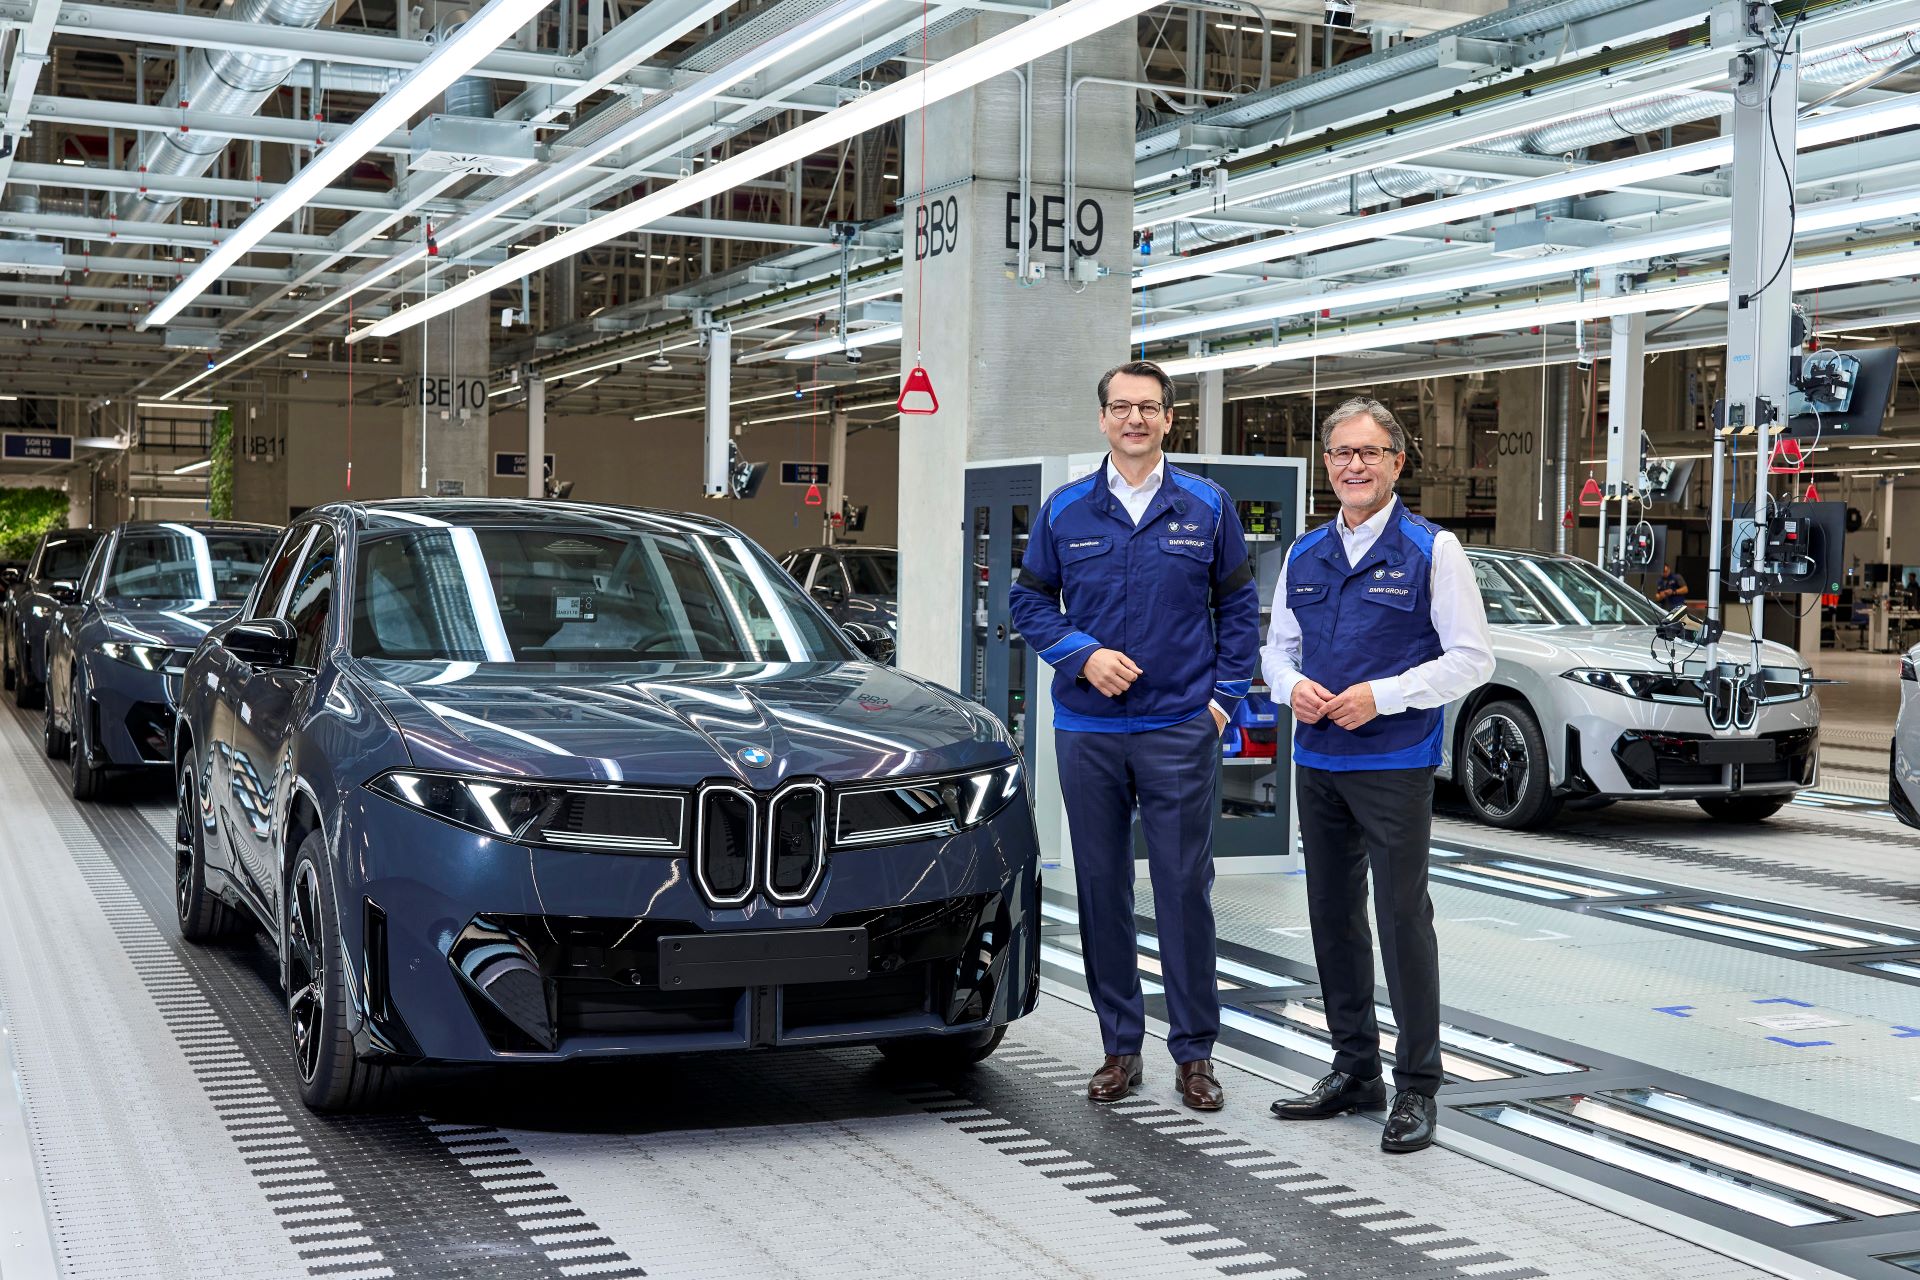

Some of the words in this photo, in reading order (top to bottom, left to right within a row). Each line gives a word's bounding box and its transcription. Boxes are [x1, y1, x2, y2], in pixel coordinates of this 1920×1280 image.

[915, 195, 958, 262] BB9
[1498, 431, 1533, 456] CC10
[1184, 539, 1205, 547] GROUP
[1385, 587, 1409, 596] GROUP
